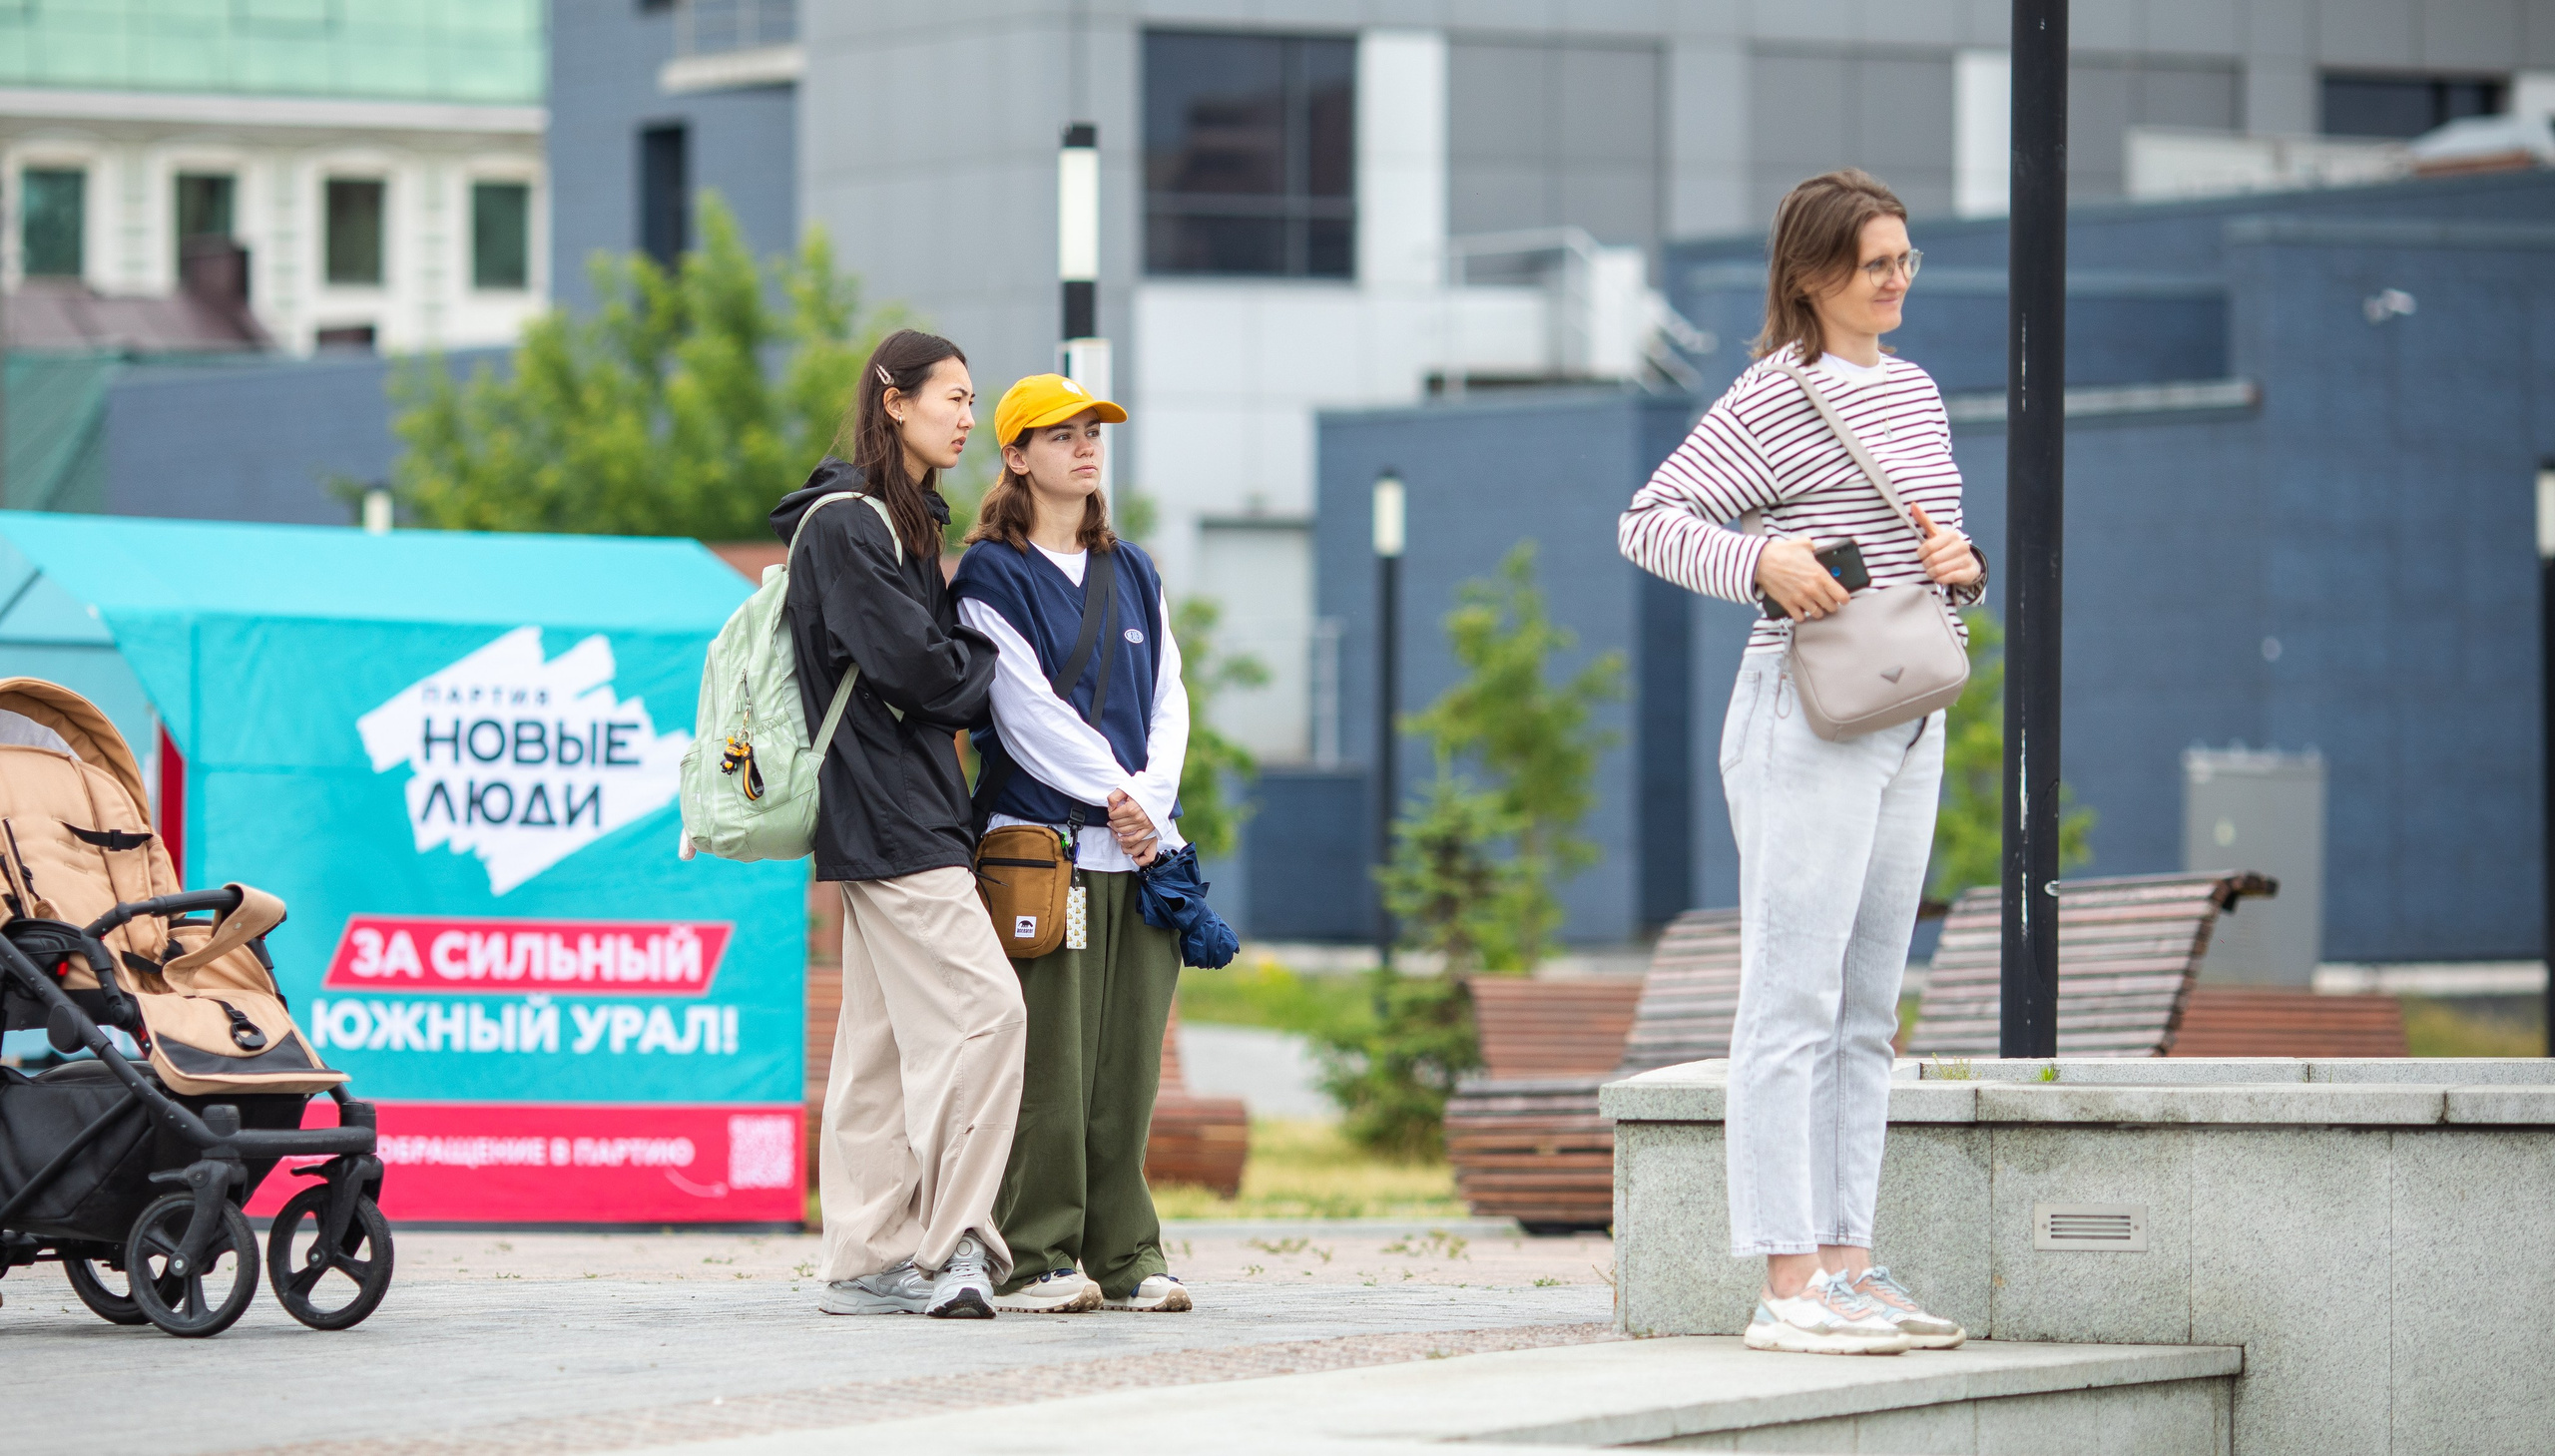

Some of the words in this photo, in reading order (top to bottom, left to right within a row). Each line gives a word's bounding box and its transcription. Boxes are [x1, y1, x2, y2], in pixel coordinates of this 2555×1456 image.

[422, 686, 549, 706] ПАРТИЯ
[423, 716, 642, 766] НОВЫЕ
[421, 778, 601, 827] ЛЮДИ
[349, 928, 424, 978] ЗА
[430, 924, 703, 982] СИЛЬНЫЙ
[311, 992, 560, 1052] ЮЖНЫЙ
[570, 1004, 740, 1055] УРАЛ!
[550, 1136, 572, 1167] В
[573, 1136, 697, 1168] ПАРТИЮ
